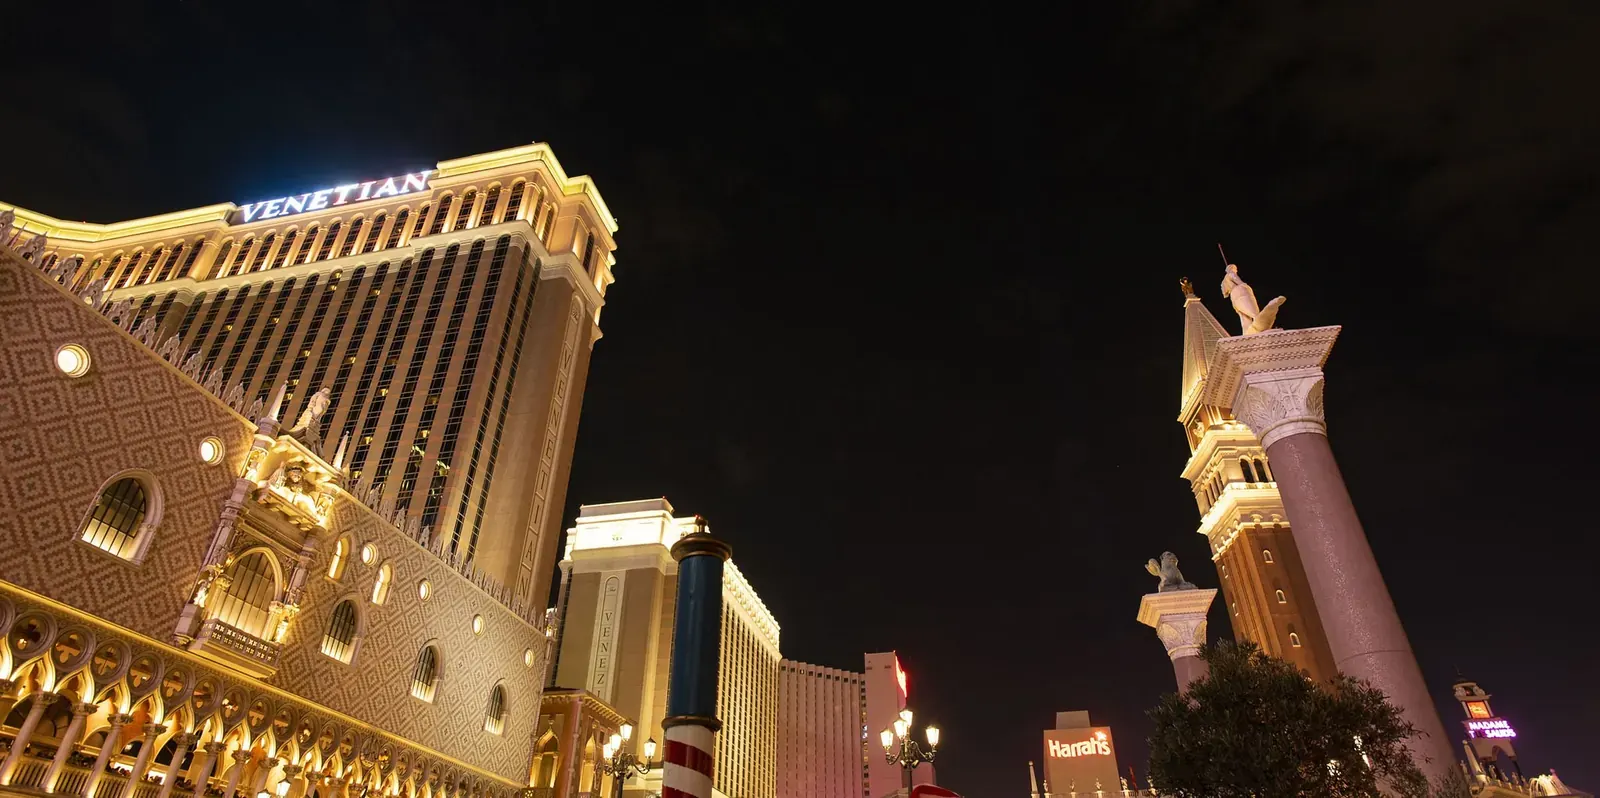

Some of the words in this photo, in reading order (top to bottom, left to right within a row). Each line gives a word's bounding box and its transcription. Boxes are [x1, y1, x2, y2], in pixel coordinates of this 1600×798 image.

[240, 169, 433, 223] VENETIAN
[517, 350, 573, 600] VENETIAN
[1469, 720, 1509, 730] MADAME
